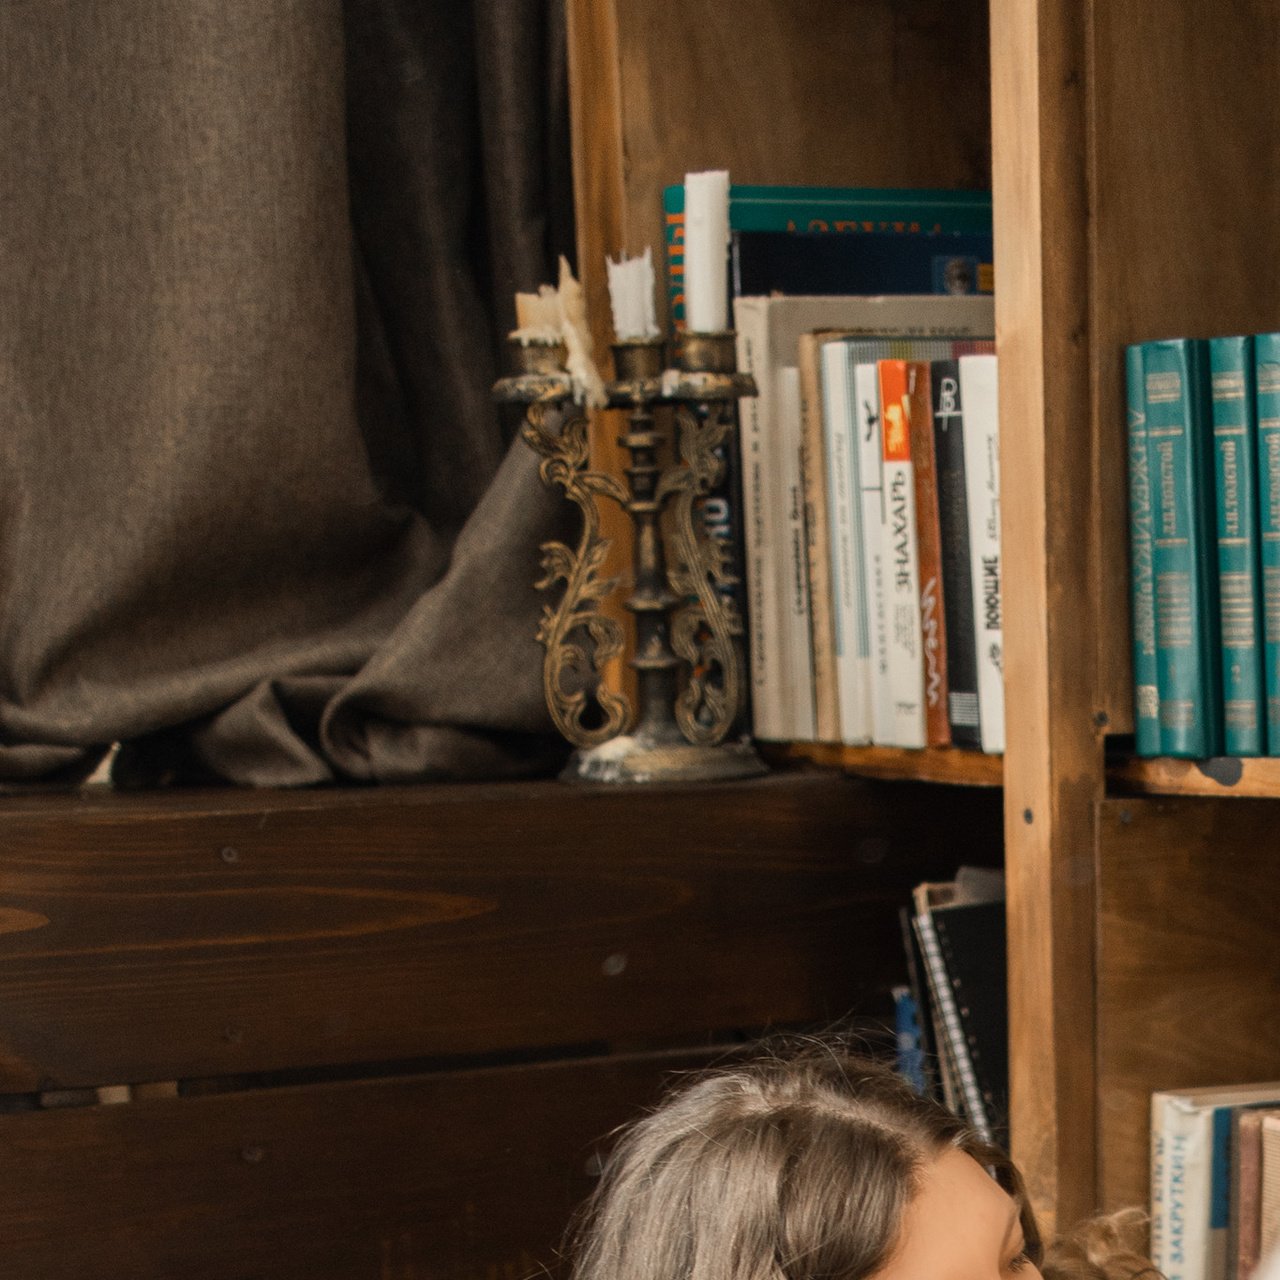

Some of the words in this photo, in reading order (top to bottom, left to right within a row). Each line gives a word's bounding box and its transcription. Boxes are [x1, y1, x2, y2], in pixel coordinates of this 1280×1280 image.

[890, 469, 913, 595] ЗНАХАРЬ
[981, 555, 1000, 631] ПОЮЩИЕ
[1169, 1132, 1187, 1263] ЗАКРУТКИН
